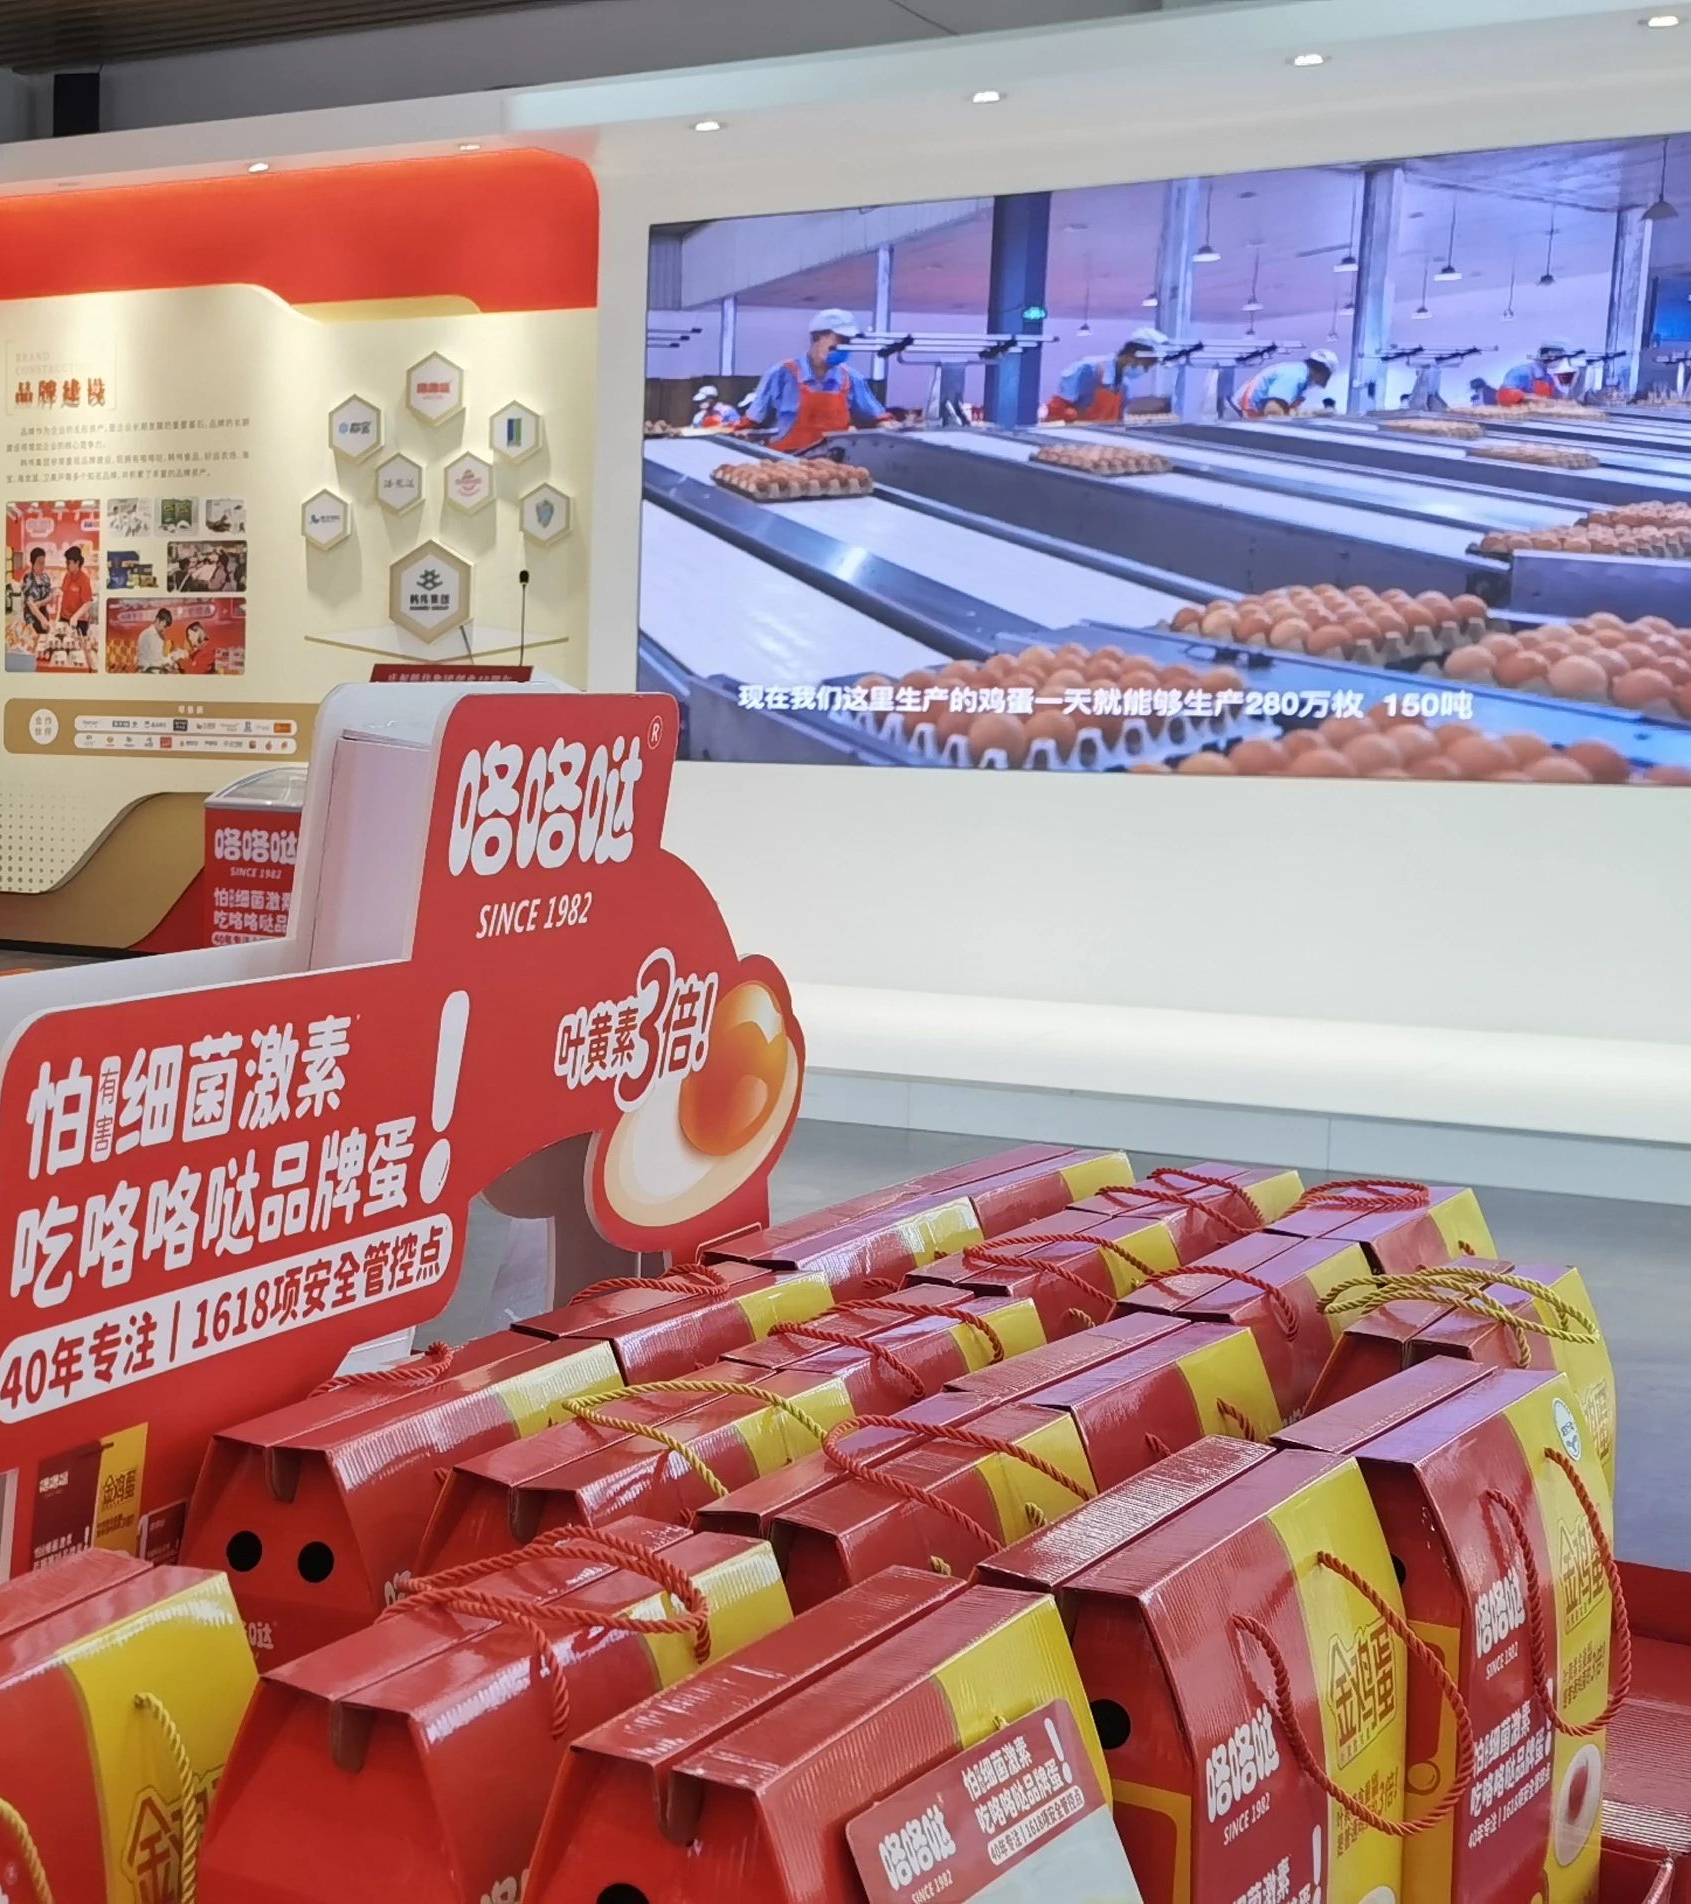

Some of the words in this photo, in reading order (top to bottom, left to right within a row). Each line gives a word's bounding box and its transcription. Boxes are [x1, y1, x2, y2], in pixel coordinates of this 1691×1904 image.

[14, 377, 107, 407] 品牌建设
[737, 684, 1365, 720] 现在我们这里生产的鸡蛋一天就能够生产280万枚
[1383, 690, 1475, 720] 150吨
[447, 735, 644, 878] 咯咯哒
[214, 828, 299, 865] 咯咯哒
[475, 898, 540, 939] SINCE
[543, 891, 594, 930] 1982
[1475, 1566, 1526, 1659] 咯咯哒
[1330, 1623, 1396, 1748] 金鸡蛋
[1206, 1702, 1280, 1824] 咯咯哒
[1223, 1815, 1250, 1847] SINCE
[1250, 1792, 1271, 1825] 1982
[878, 1804, 957, 1891] 咯咯哒
[934, 1869, 954, 1894] 1982
